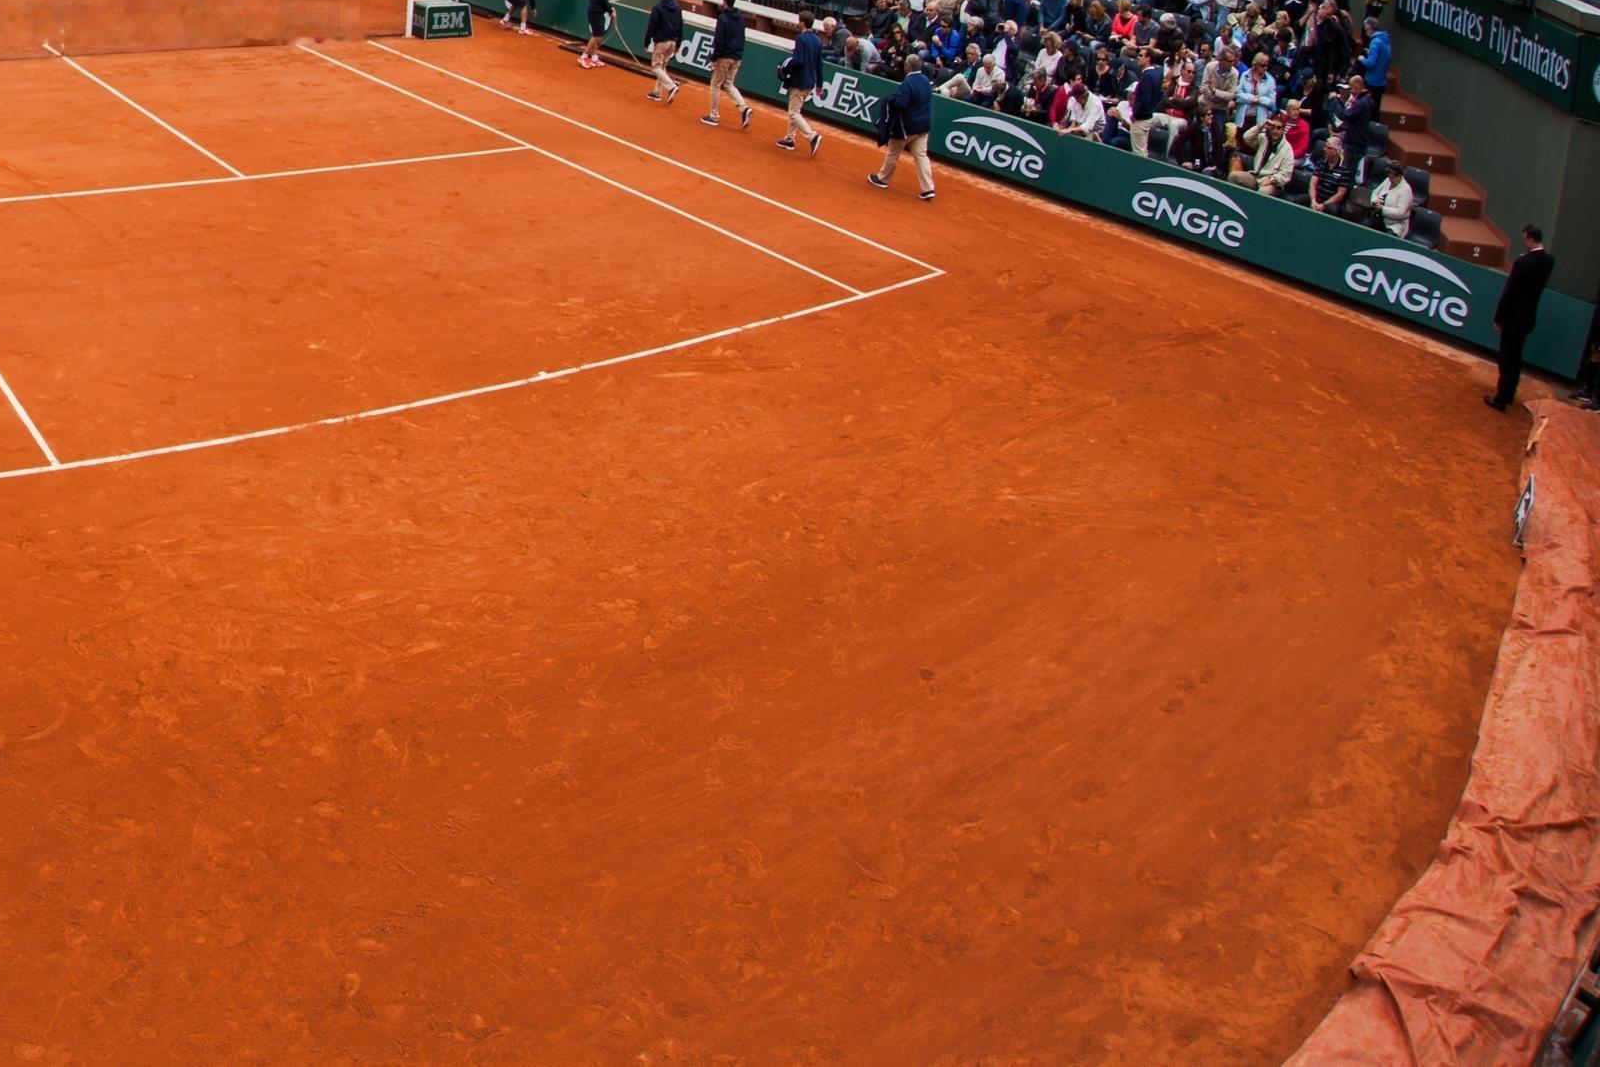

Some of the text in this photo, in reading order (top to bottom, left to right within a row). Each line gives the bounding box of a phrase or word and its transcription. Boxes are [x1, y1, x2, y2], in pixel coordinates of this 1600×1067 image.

[432, 11, 465, 30] IBM
[1487, 14, 1511, 65] Fly
[1509, 25, 1572, 91] Emirates
[1426, 155, 1433, 167] 4
[1473, 246, 1480, 257] 2
